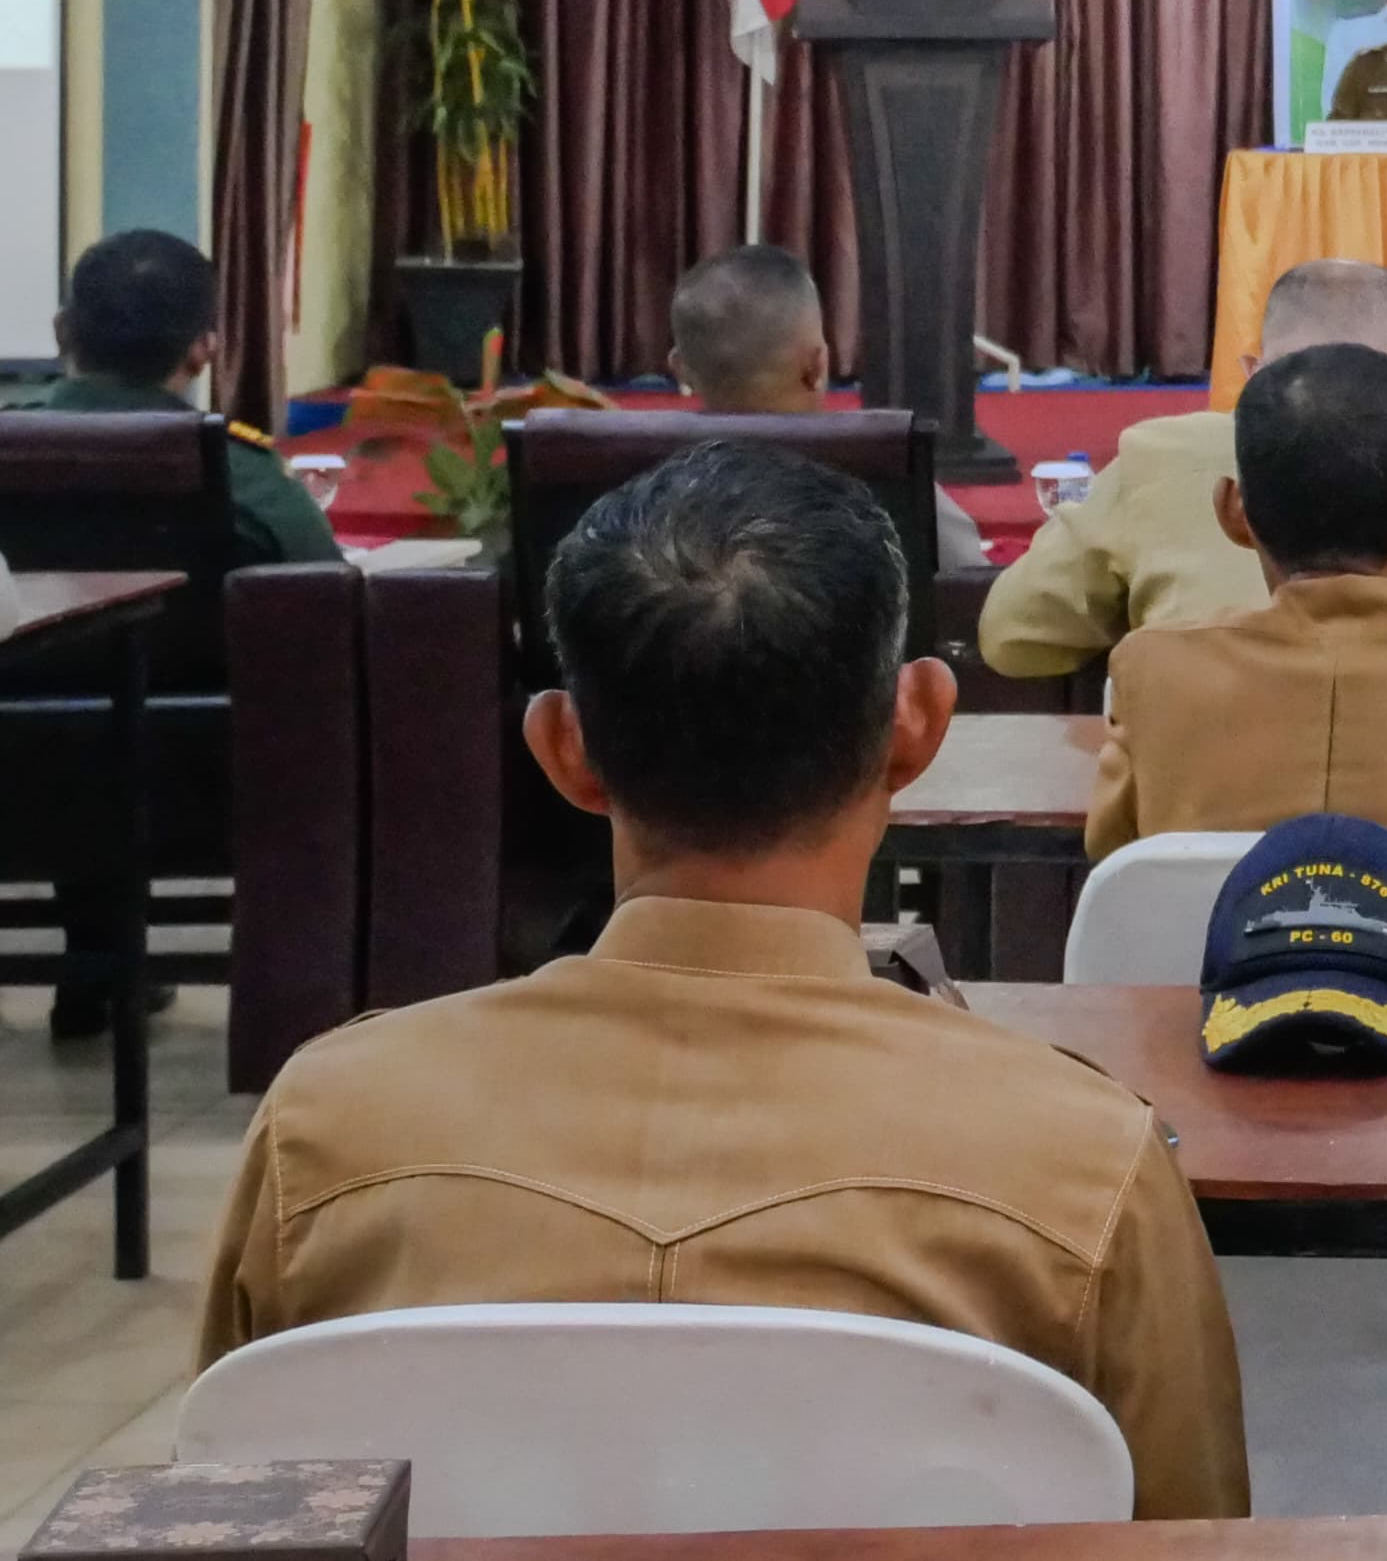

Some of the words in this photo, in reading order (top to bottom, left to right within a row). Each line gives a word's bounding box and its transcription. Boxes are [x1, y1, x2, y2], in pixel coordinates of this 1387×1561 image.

[1260, 873, 1289, 896] KRI
[1293, 864, 1344, 878] TUNA
[1289, 930, 1314, 943] PC
[1331, 931, 1354, 944] 60
